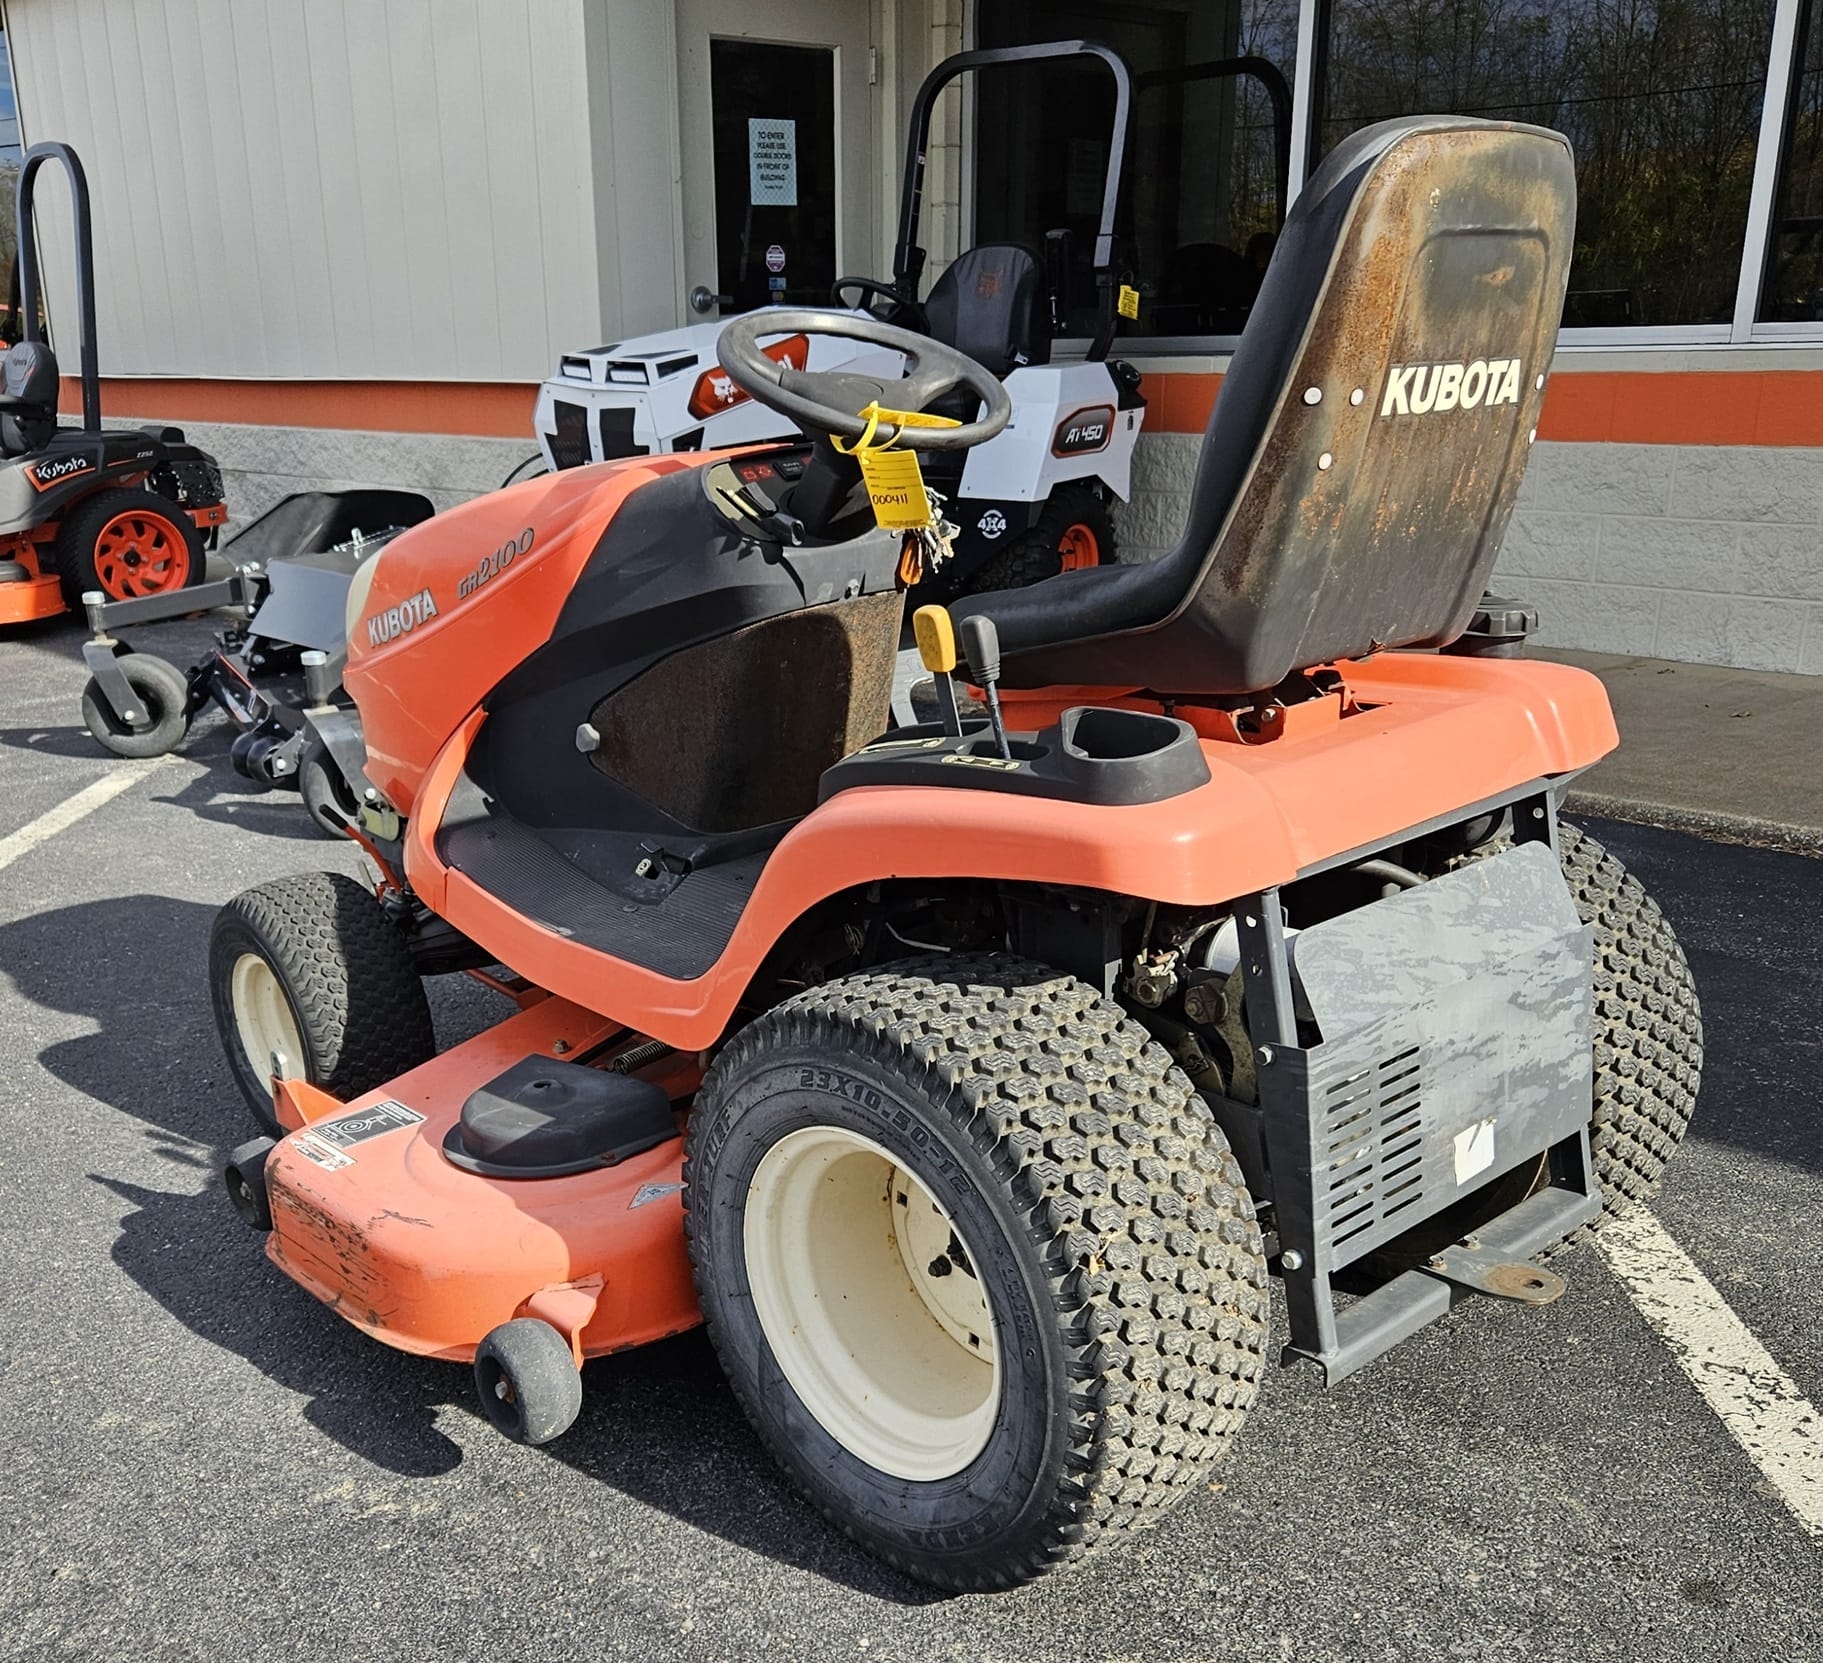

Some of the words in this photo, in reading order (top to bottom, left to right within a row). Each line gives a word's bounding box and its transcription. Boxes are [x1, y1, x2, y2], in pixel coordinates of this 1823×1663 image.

[757, 142, 775, 150] PLEASE
[776, 142, 786, 150] USE
[758, 131, 766, 140] TO
[767, 131, 785, 140] ENTER
[1380, 358, 1521, 417] KUBOTA
[36, 457, 87, 479] Kubota
[872, 493, 908, 505] 000411
[457, 527, 535, 600] GR2100
[367, 587, 439, 648] KUBOTA
[703, 1108, 732, 1173] TURF
